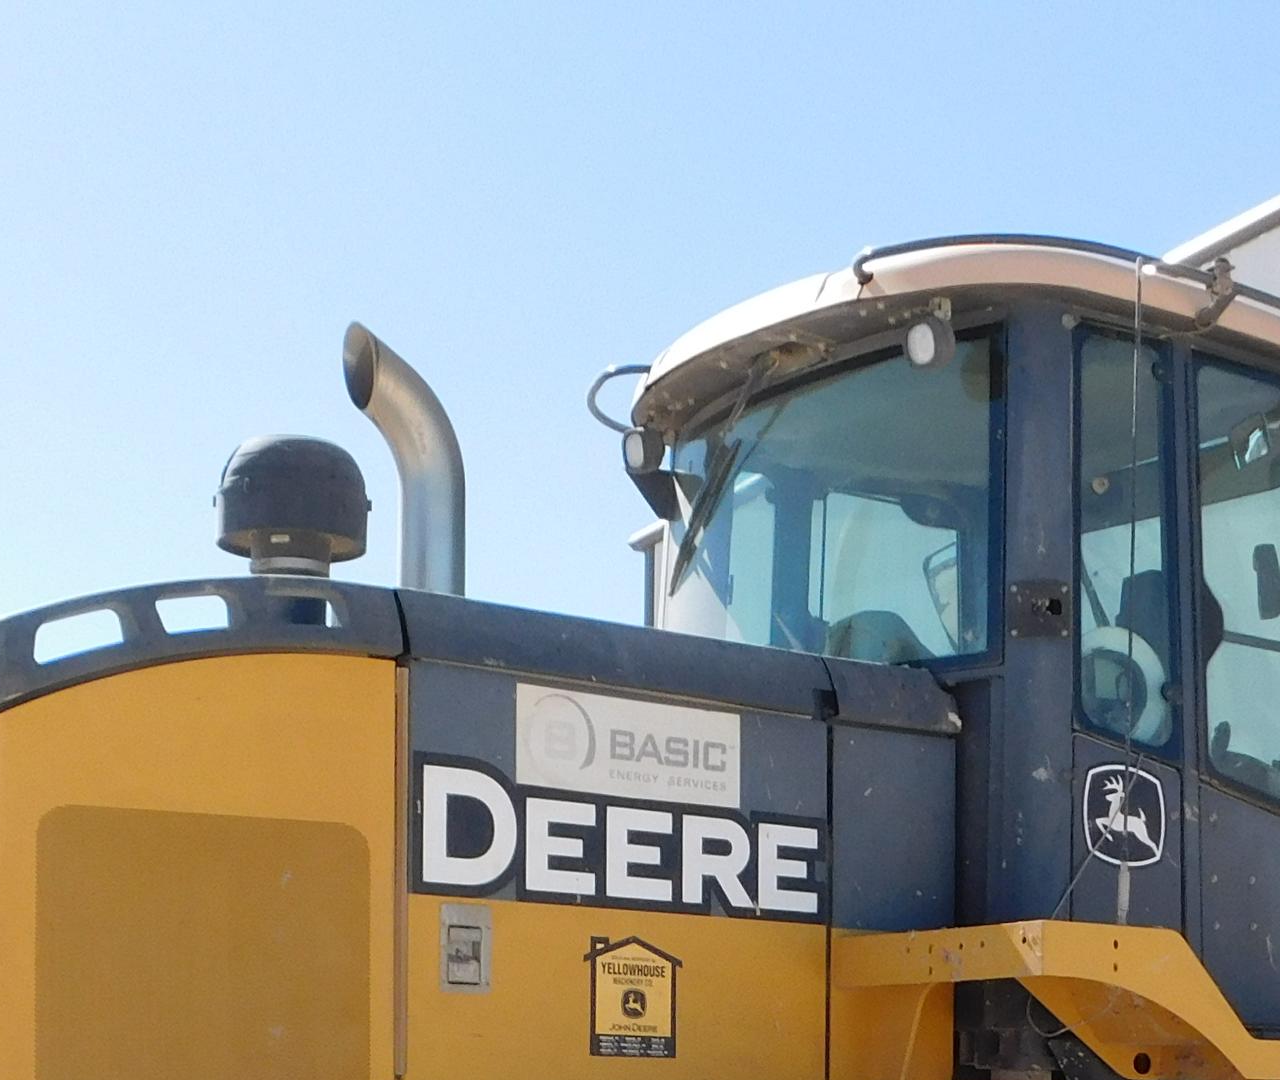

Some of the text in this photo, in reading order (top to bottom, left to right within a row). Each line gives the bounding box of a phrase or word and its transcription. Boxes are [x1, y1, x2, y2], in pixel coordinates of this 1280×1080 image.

[609, 728, 727, 772] BASIC
[609, 769, 727, 792] ENERGY SERVICES
[422, 764, 819, 914] DEERE
[601, 961, 666, 979] YELLOWHOUSE
[609, 1022, 632, 1032] JOHN
